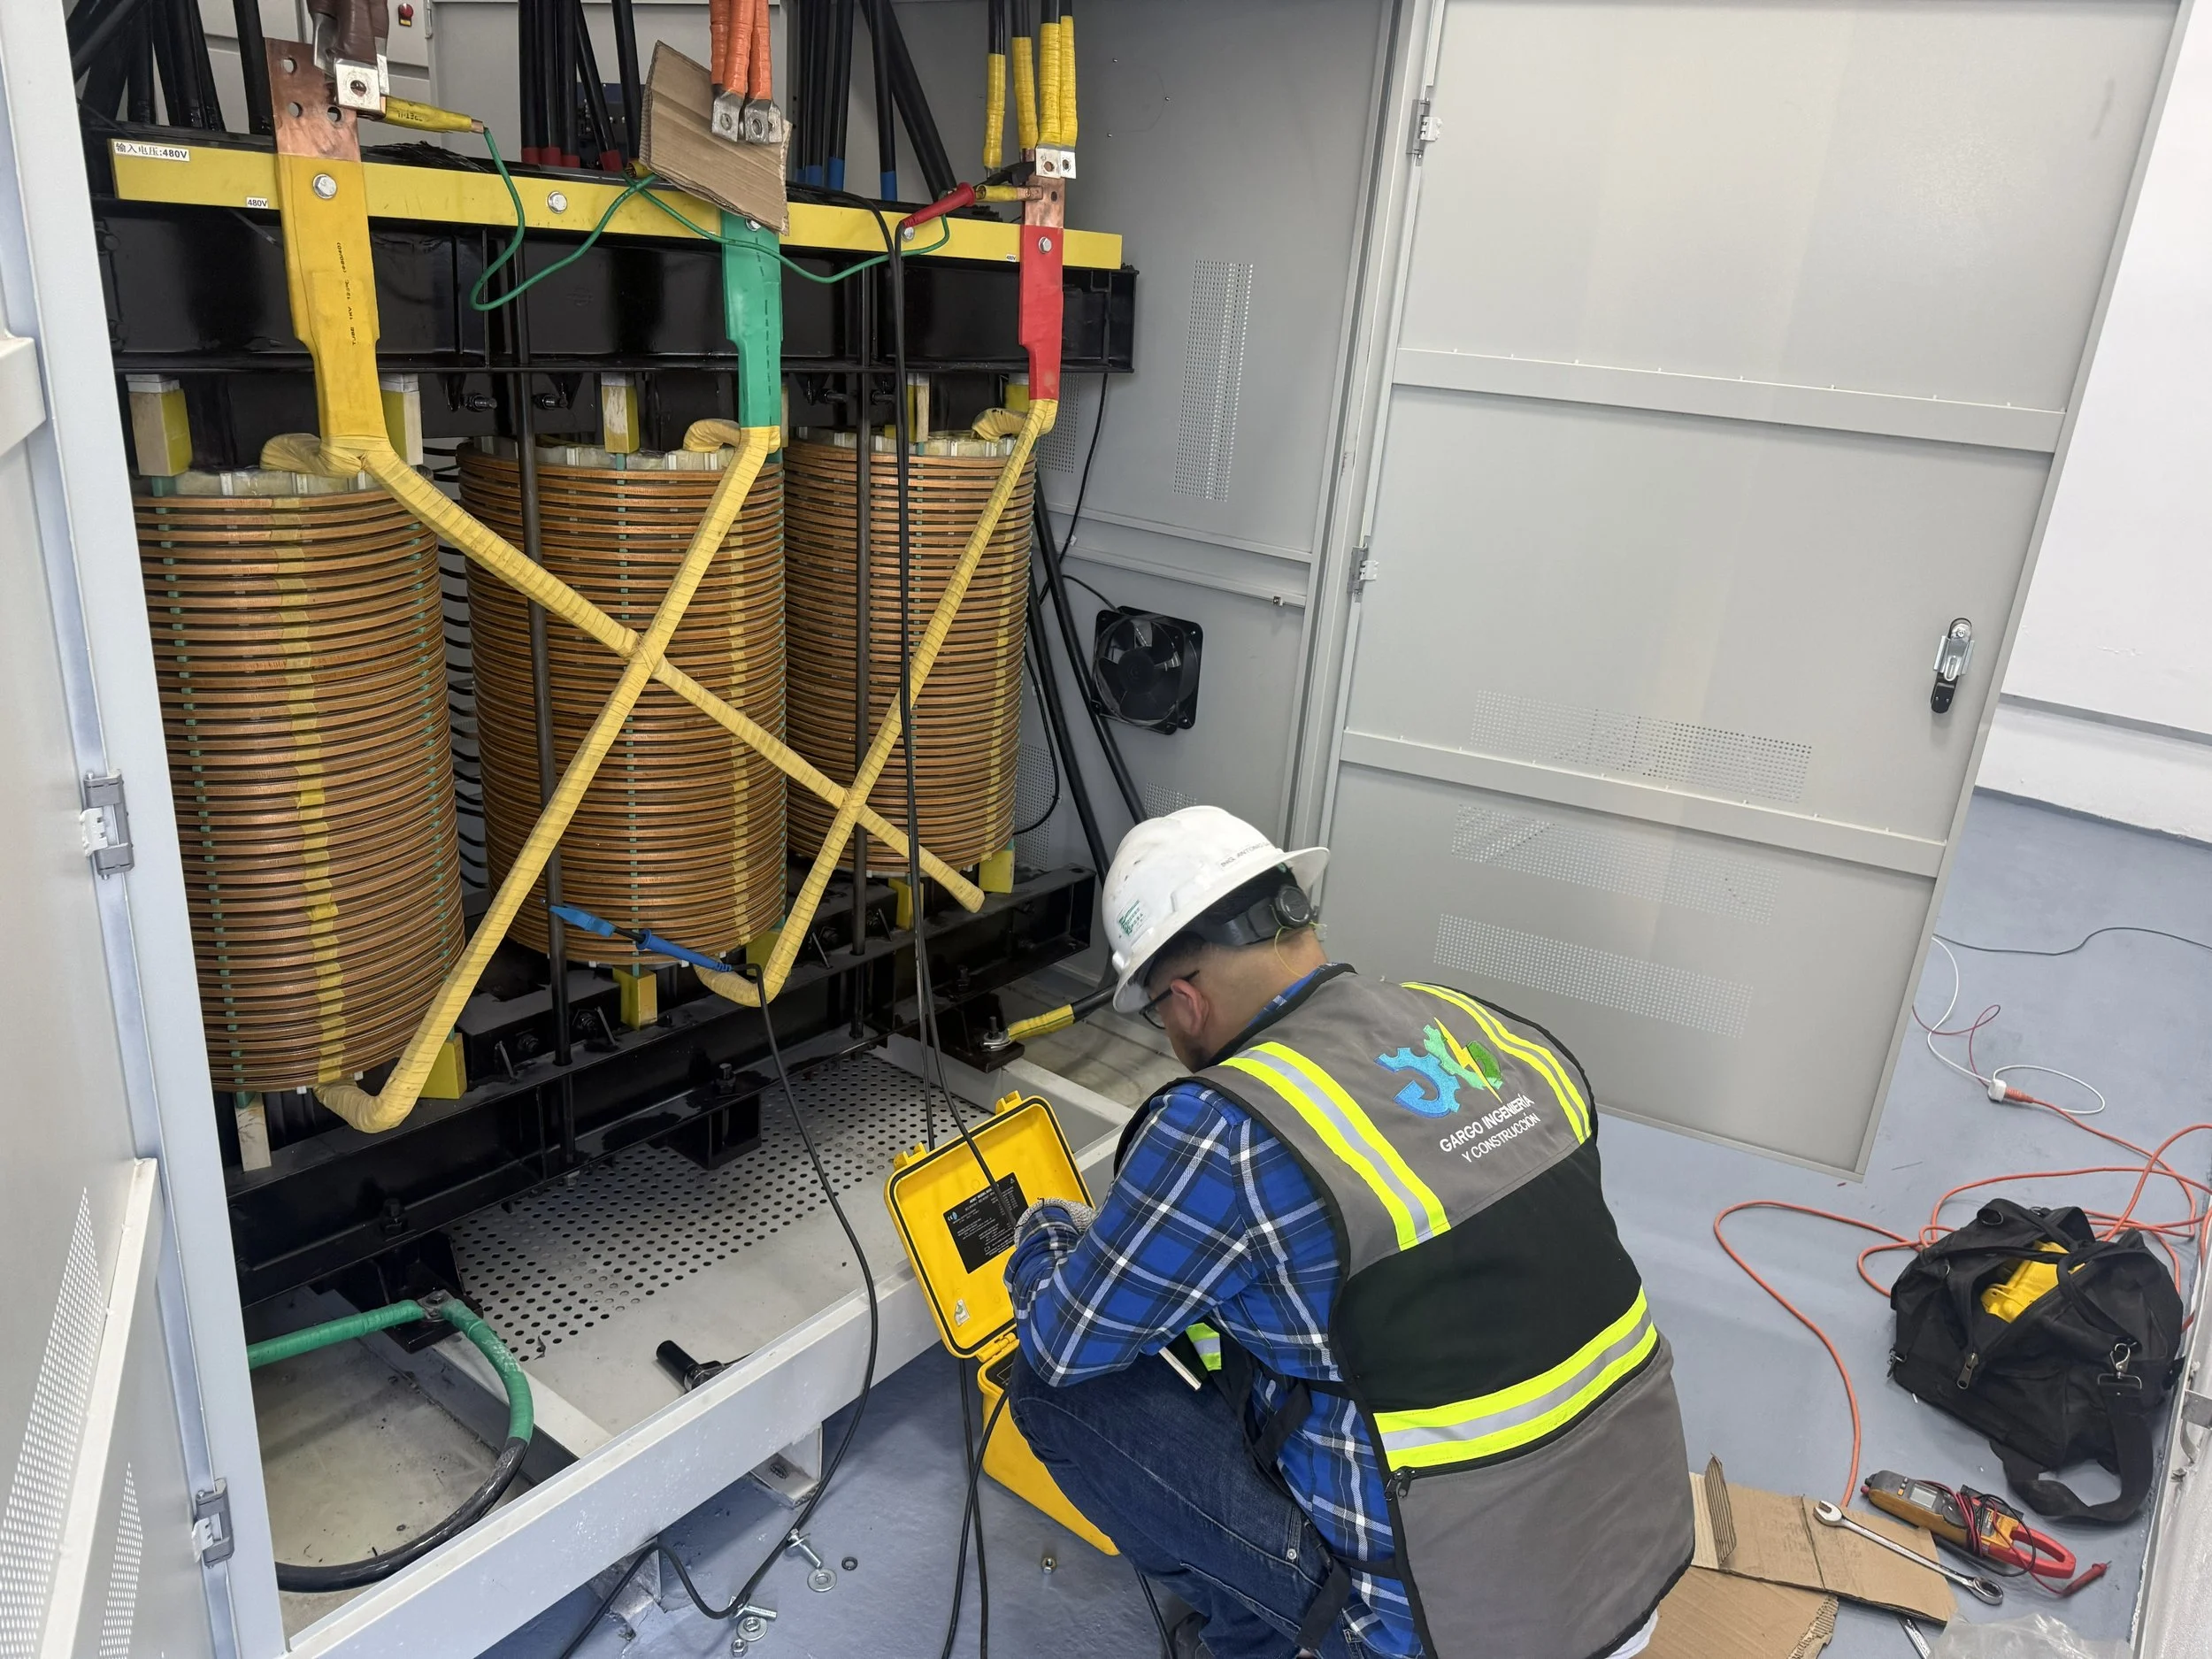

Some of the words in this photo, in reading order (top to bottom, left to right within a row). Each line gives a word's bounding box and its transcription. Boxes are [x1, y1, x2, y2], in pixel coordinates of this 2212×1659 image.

[247, 198, 267, 207] 480V
[1440, 1121, 1484, 1152] GARGO
[1481, 1093, 1535, 1130] INGENIERÍA
[1461, 1150, 1472, 1163] Y
[1471, 1112, 1541, 1158] CONSTRUCCIÓN
